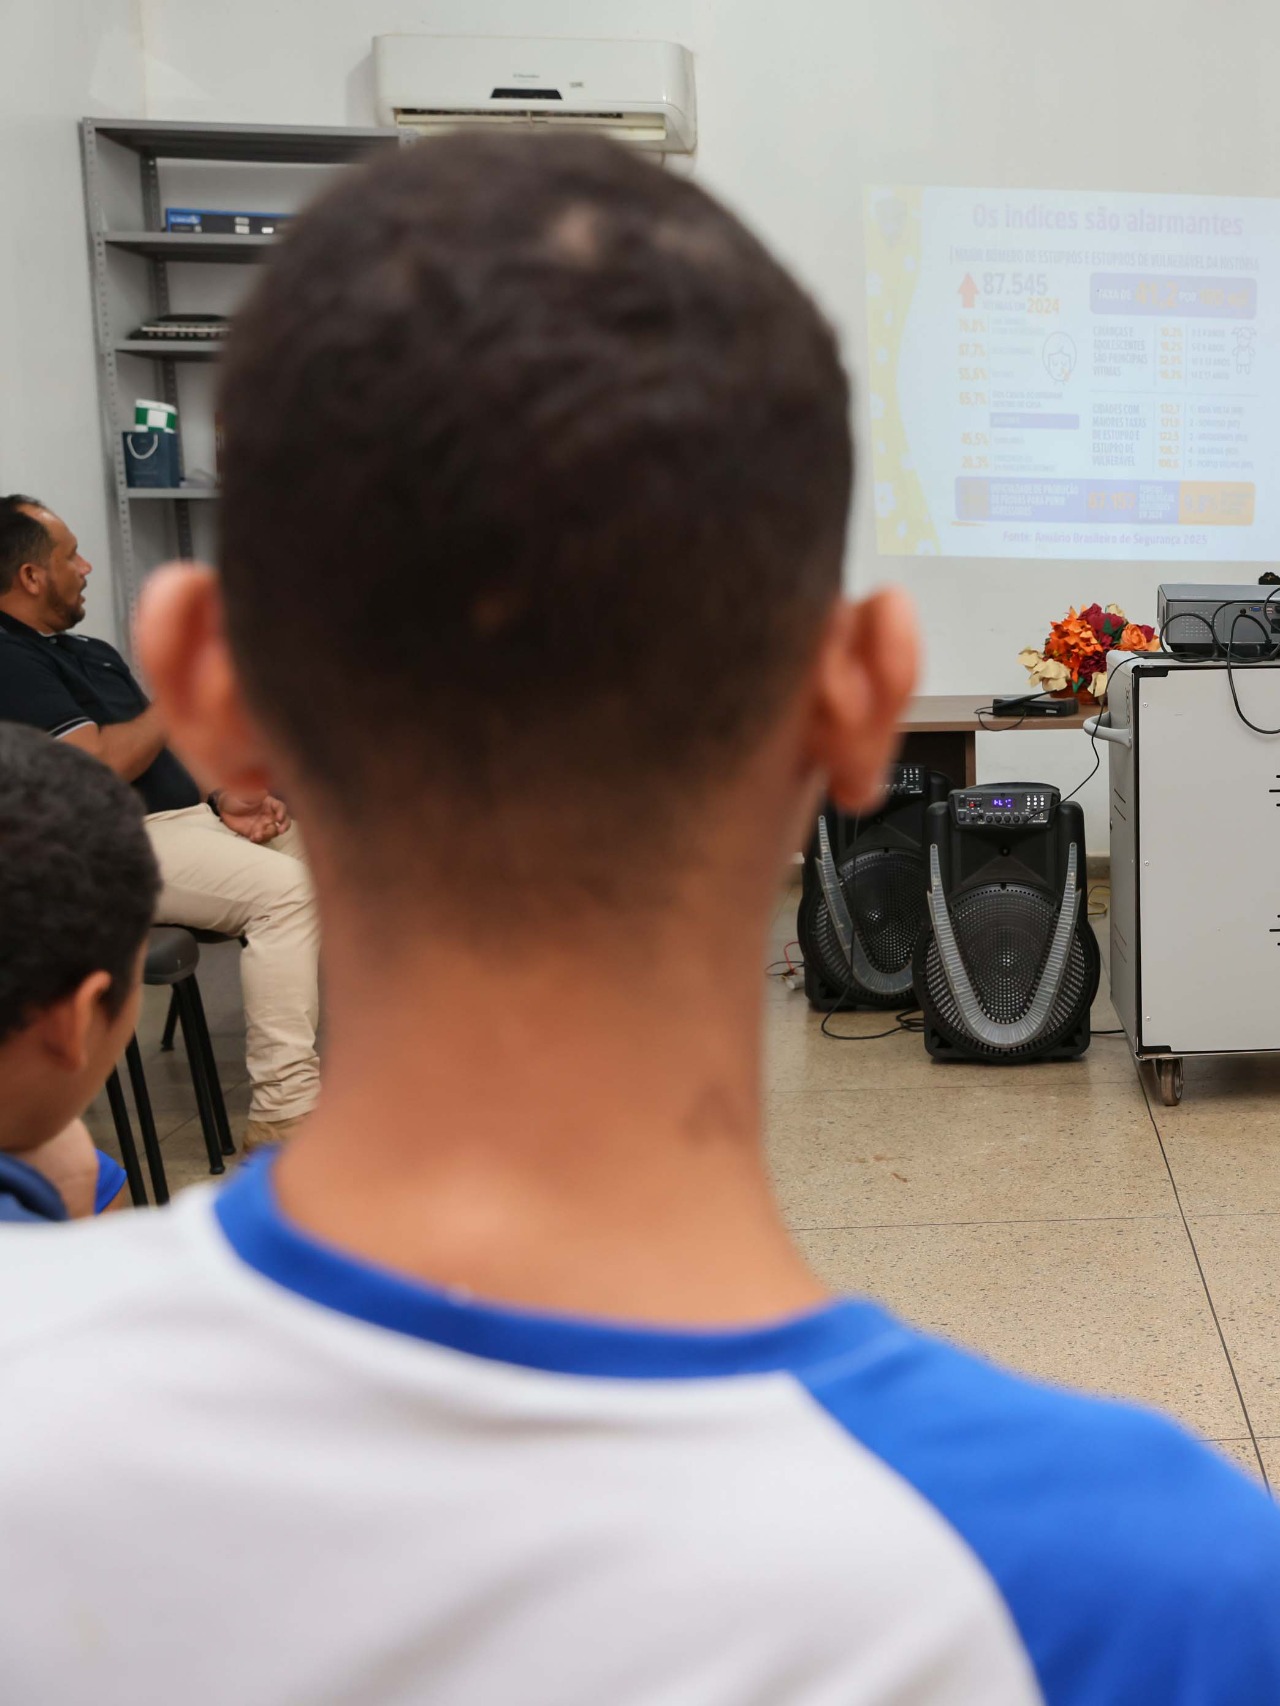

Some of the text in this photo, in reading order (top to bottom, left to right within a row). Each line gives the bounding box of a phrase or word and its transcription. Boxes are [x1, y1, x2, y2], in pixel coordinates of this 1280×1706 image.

[973, 203, 998, 229] Os
[1086, 205, 1120, 232] são
[1127, 207, 1244, 236] alarmantes
[983, 272, 1048, 297] 87.545
[1027, 297, 1060, 314] 2024
